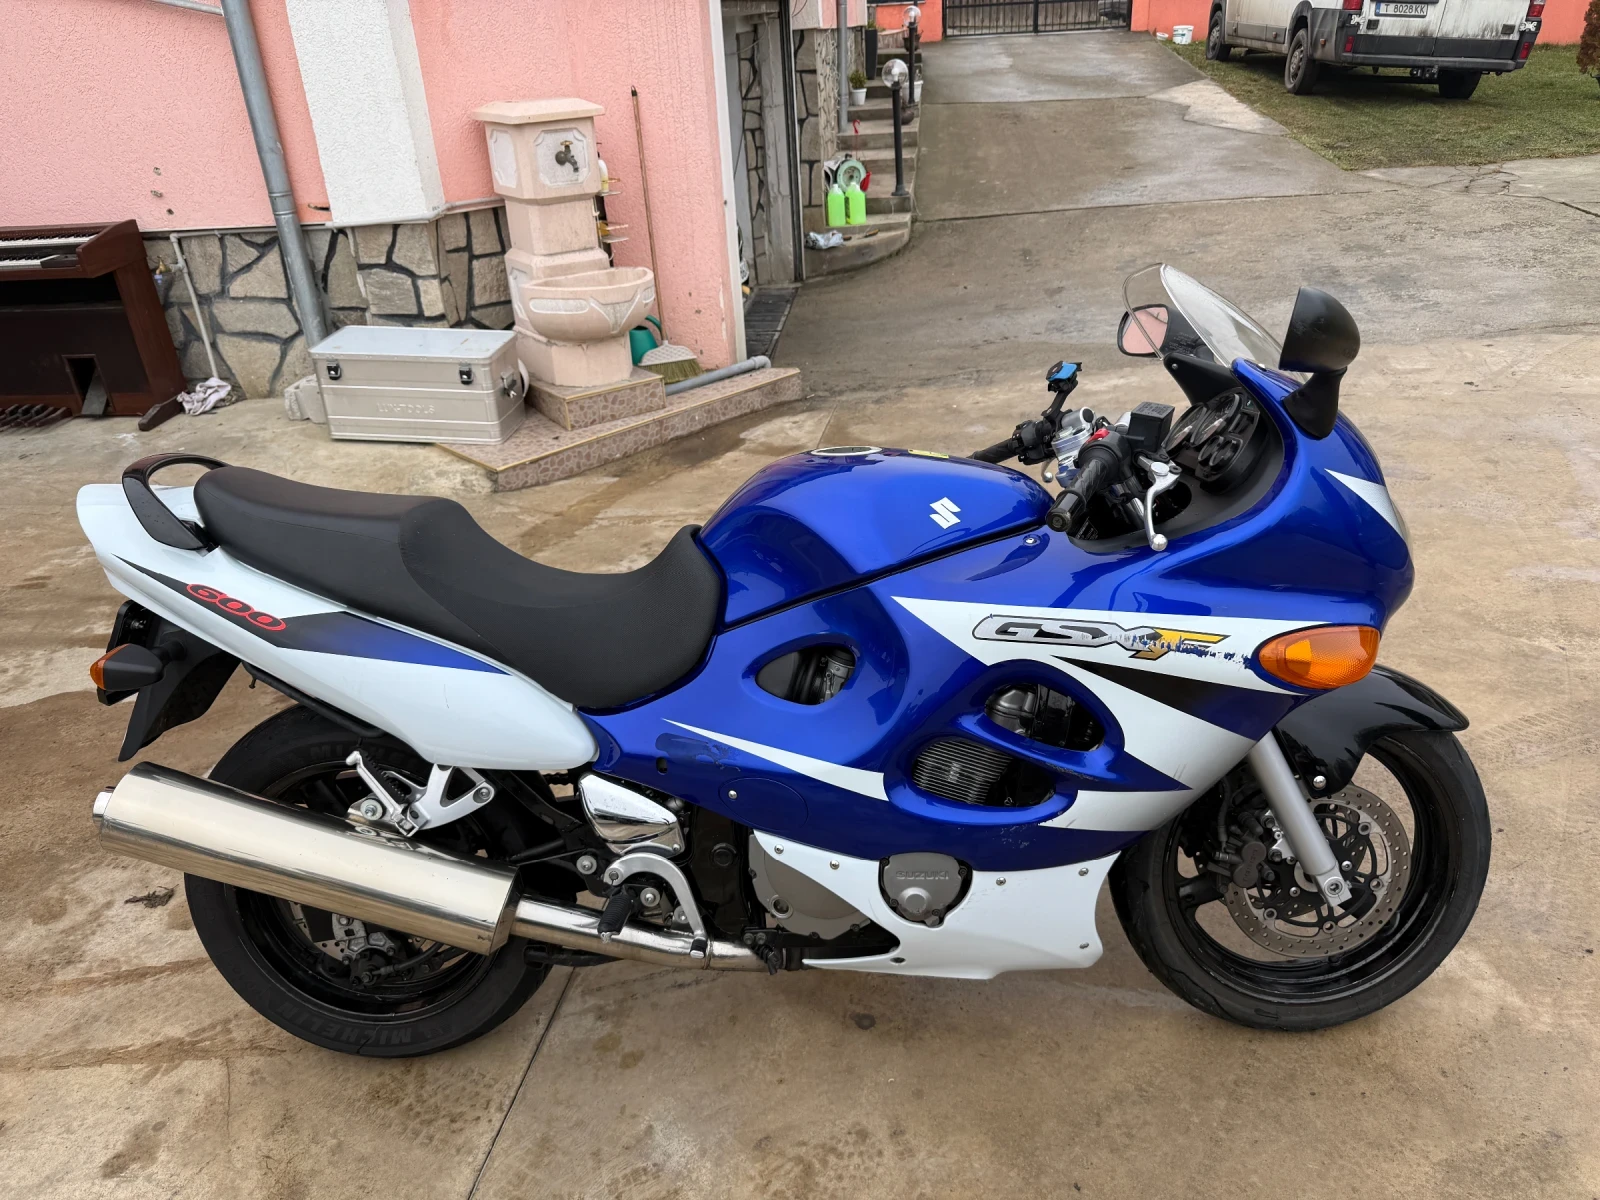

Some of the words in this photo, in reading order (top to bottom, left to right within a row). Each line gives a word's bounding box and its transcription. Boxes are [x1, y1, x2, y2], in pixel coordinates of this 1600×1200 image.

[186, 583, 286, 631] 600
[896, 870, 949, 880] SUZUKI
[277, 1001, 412, 1045] MICHELIN
